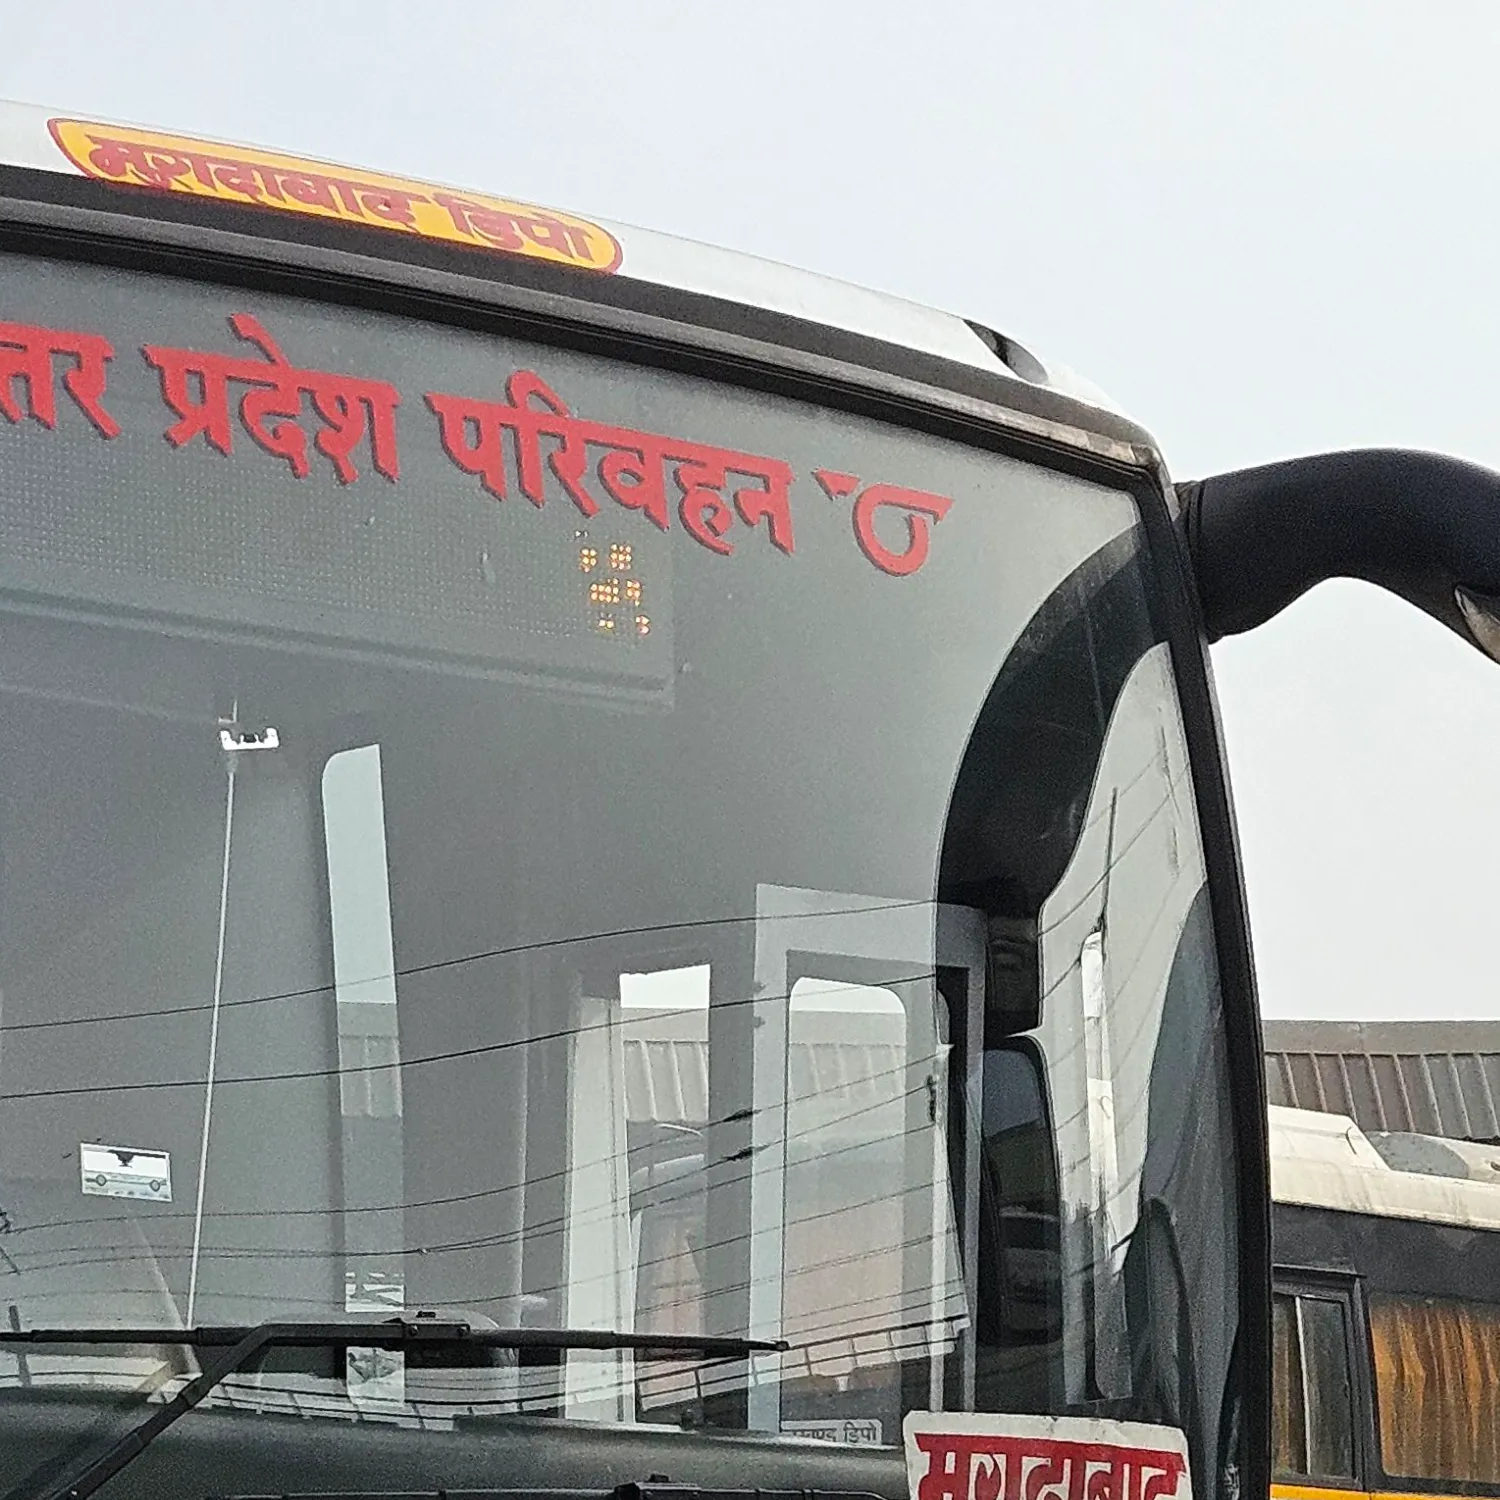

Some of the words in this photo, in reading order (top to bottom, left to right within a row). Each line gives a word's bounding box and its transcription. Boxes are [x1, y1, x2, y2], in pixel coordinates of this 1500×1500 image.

[432, 192, 595, 261] डिपो
[141, 313, 400, 484] प्रदेश
[425, 369, 796, 556] परिवहन
